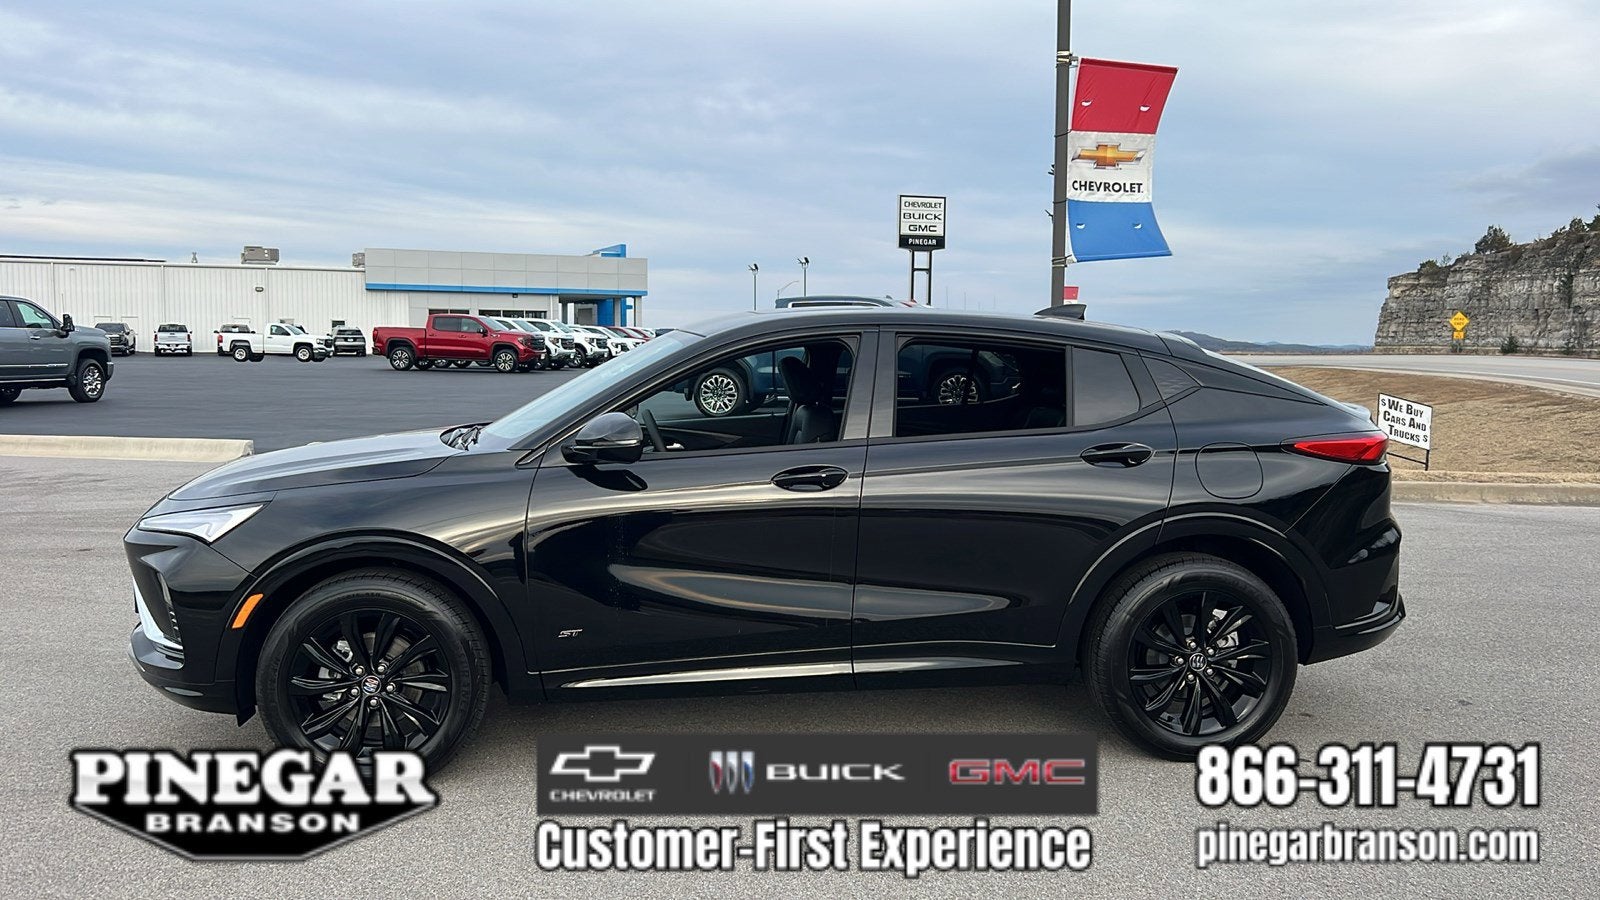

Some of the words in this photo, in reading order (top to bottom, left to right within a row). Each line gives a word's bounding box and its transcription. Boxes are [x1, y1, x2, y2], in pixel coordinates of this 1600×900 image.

[903, 212, 942, 221] BUICK
[908, 224, 937, 232] GMC
[558, 628, 583, 638] ST
